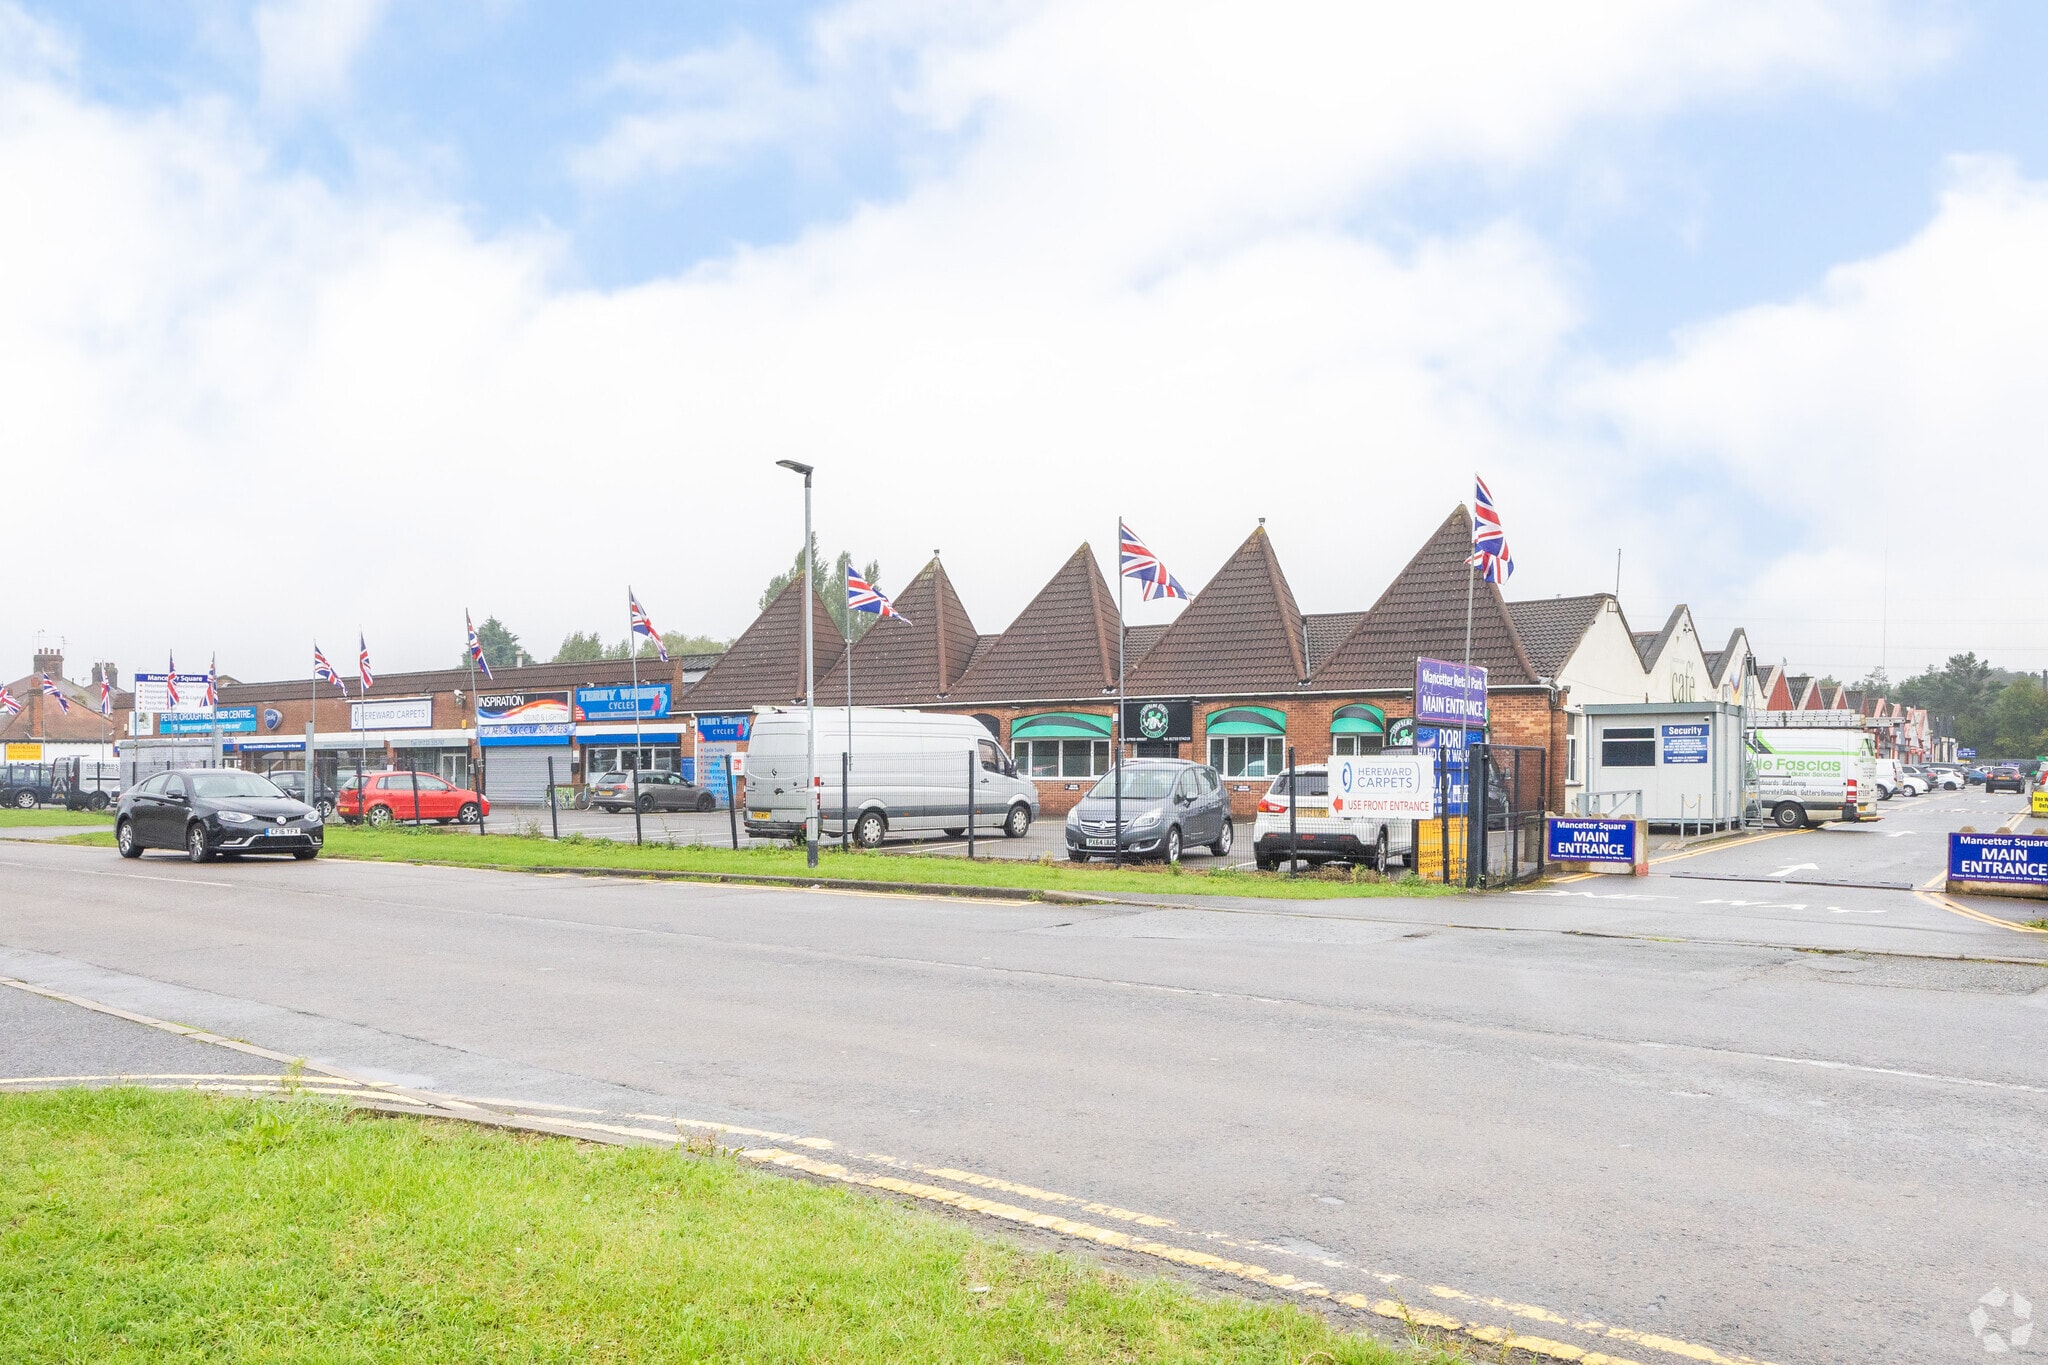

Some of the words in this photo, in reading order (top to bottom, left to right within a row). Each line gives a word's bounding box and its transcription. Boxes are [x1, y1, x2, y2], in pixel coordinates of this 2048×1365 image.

[1422, 668, 1453, 686] Mancetter
[1454, 674, 1471, 689] Retal
[1471, 676, 1483, 690] Park
[478, 695, 524, 707] INSPIRATION
[579, 689, 617, 702] TERRY
[608, 701, 635, 710] CYCLES
[1422, 695, 1444, 713] MAIN
[1445, 698, 1483, 717] ENTRANCE
[229, 709, 251, 719] CENTRE
[396, 709, 425, 719] CARPETS
[700, 717, 720, 726] TERRY
[1668, 726, 1702, 736] Security
[1439, 728, 1462, 749] DORI
[1439, 748, 1451, 762] CR
[1776, 758, 1841, 772] Fascias
[1358, 767, 1412, 776] HEREWARD
[1357, 777, 1413, 789] CARPETS
[1348, 800, 1362, 810] USE
[1363, 801, 1387, 811] FRONT
[1389, 801, 1430, 812] ENTRANCE
[1557, 822, 1598, 830] Mancetter
[1598, 822, 1627, 831] Square
[1573, 831, 1609, 843] MAIN
[1960, 836, 2012, 846] Mancetter
[2014, 838, 2048, 848] Square
[1558, 842, 1625, 855] ENTRANCE
[1981, 848, 2028, 862] MAIN
[1961, 860, 2048, 876] ENTRANCE
